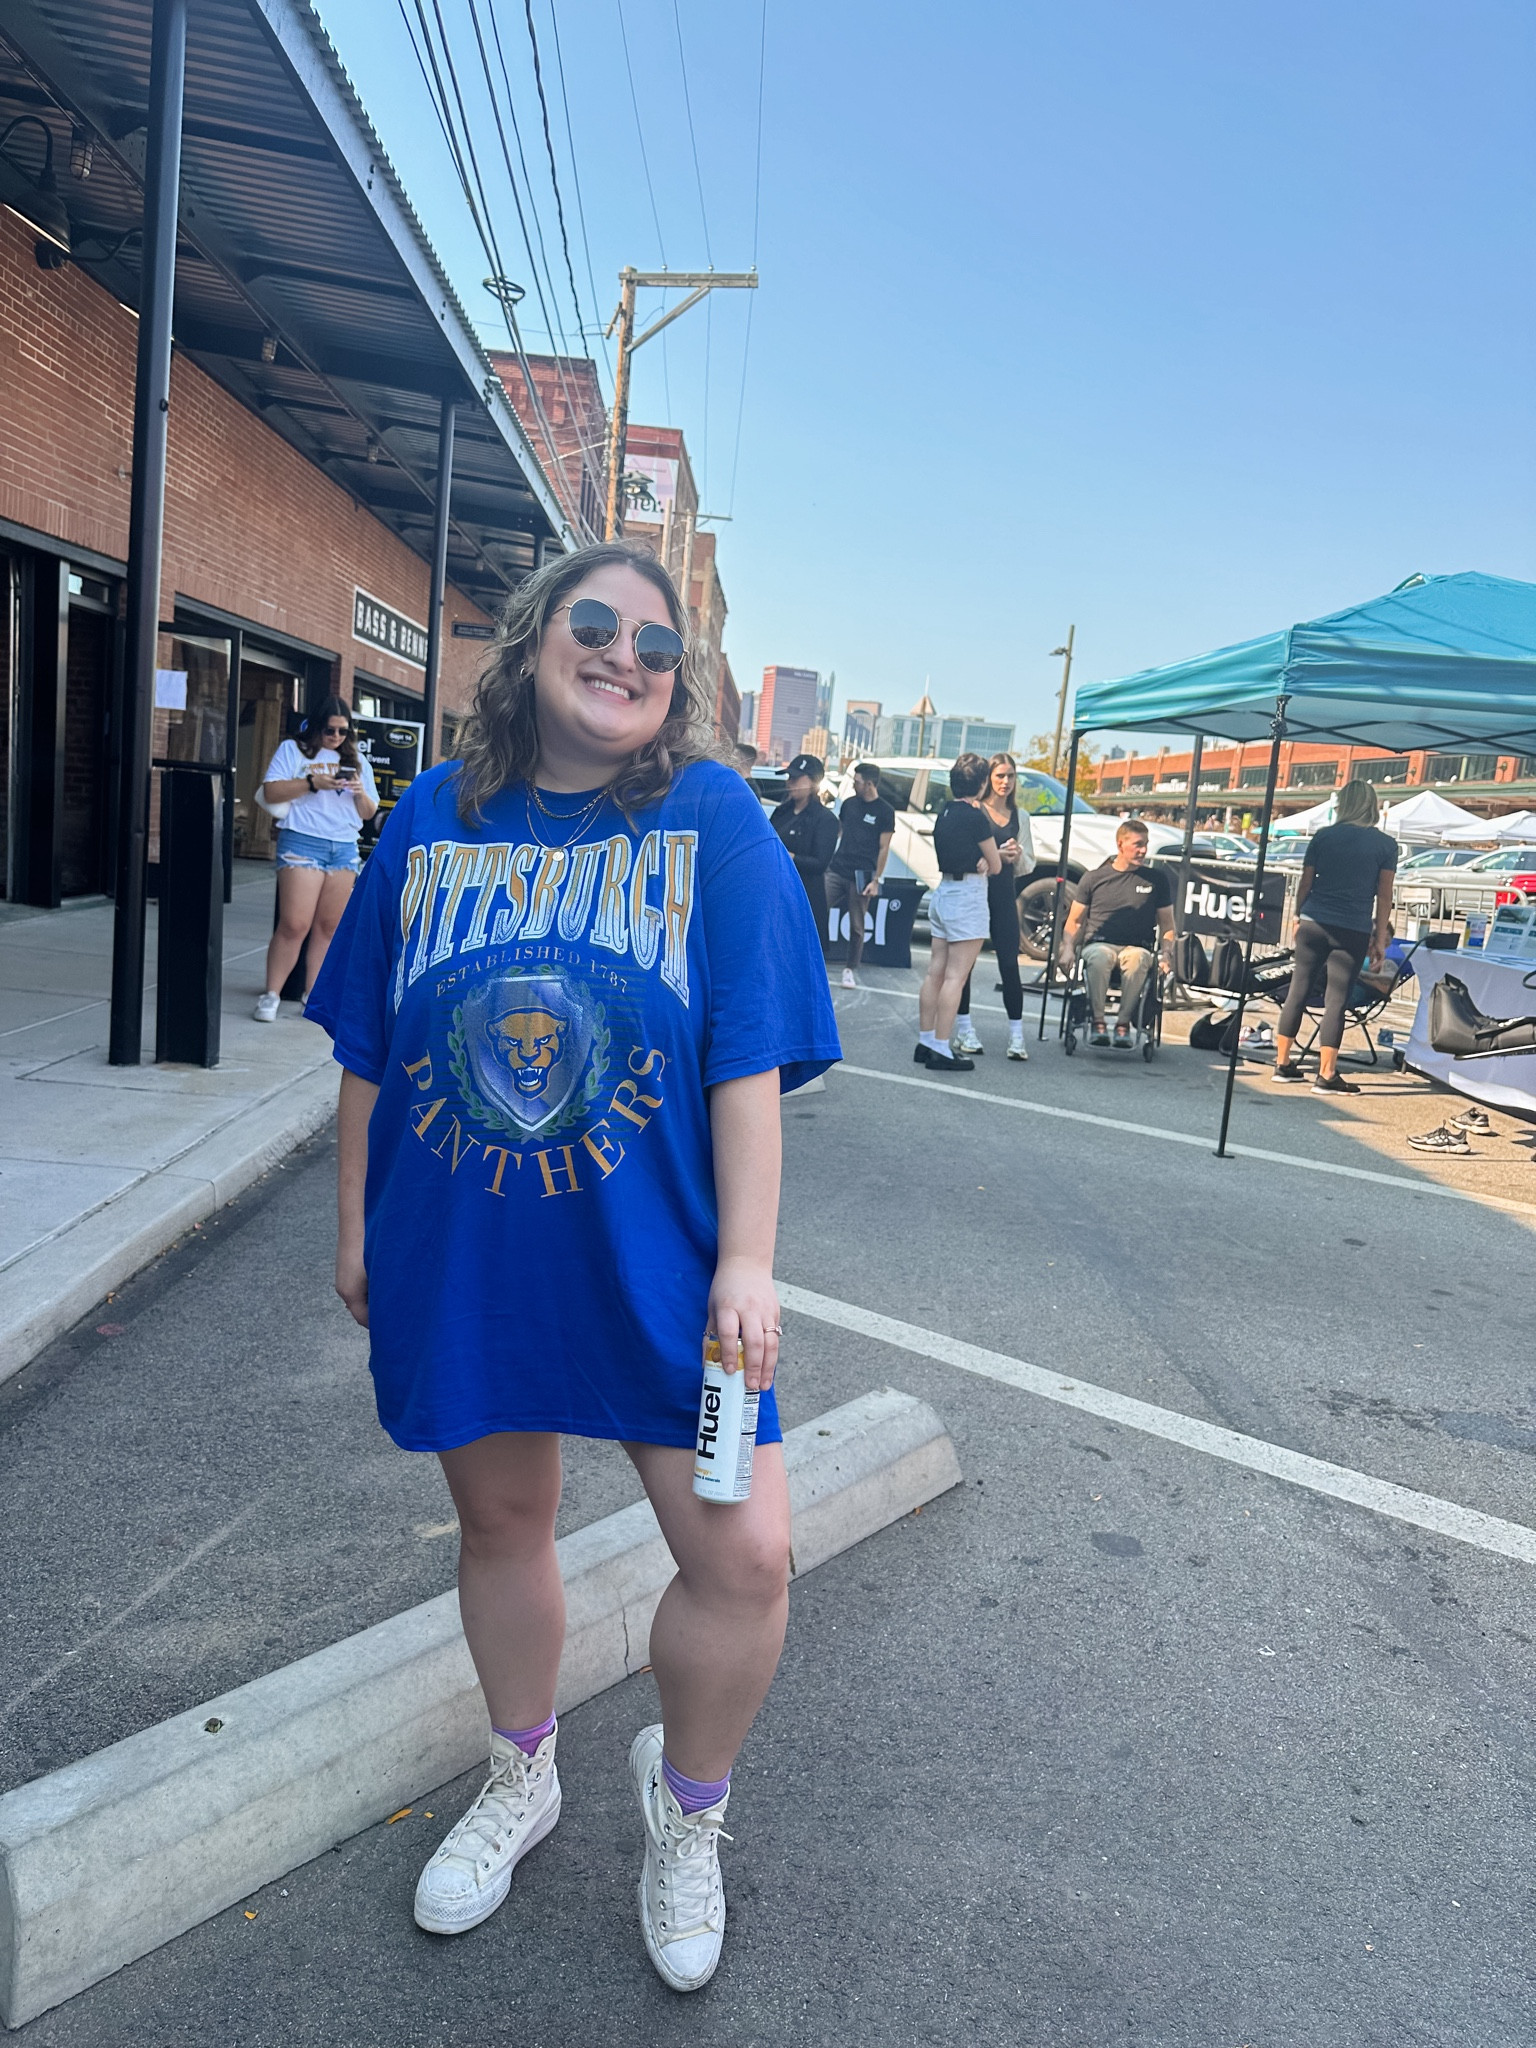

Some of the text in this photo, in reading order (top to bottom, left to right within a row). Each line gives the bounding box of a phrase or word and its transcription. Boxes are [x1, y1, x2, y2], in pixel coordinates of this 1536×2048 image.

[356, 601, 386, 641] BASS
[390, 619, 397, 649] &
[395, 829, 699, 1015] PITTSBURGH
[1184, 881, 1254, 923] Huel
[436, 945, 628, 998] ESTABLISHED 1787
[401, 1044, 666, 1199] PANTHERS
[697, 1384, 721, 1460] Huel
